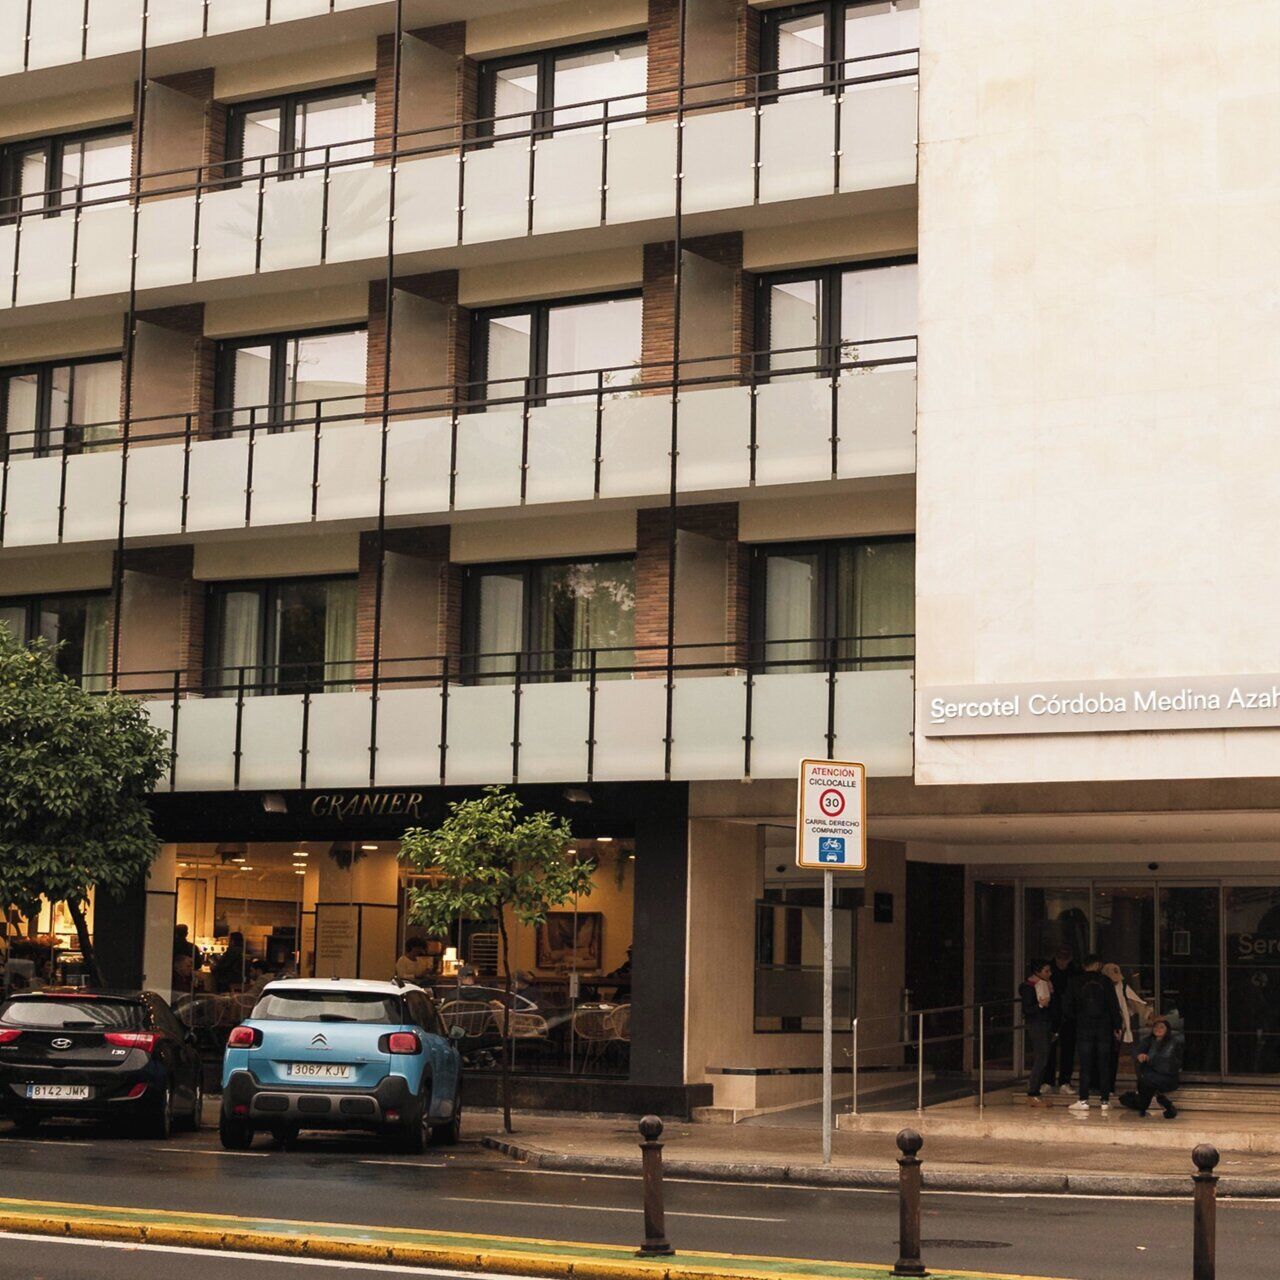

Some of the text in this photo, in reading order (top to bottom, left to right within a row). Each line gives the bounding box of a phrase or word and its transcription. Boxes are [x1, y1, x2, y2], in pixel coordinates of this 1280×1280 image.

[930, 695, 1019, 724] Sercotel
[1028, 693, 1126, 716] Córdoba
[1134, 688, 1220, 713] Medina
[809, 778, 857, 788] CICLOCALLE
[311, 792, 423, 820] GRANIER
[825, 798, 839, 808] 30
[805, 818, 860, 827] CARRIL DERECHO
[811, 827, 853, 835] COMPARTIDO
[295, 1065, 348, 1076] 3067 KJV
[34, 1086, 87, 1096] 8142 JMK
